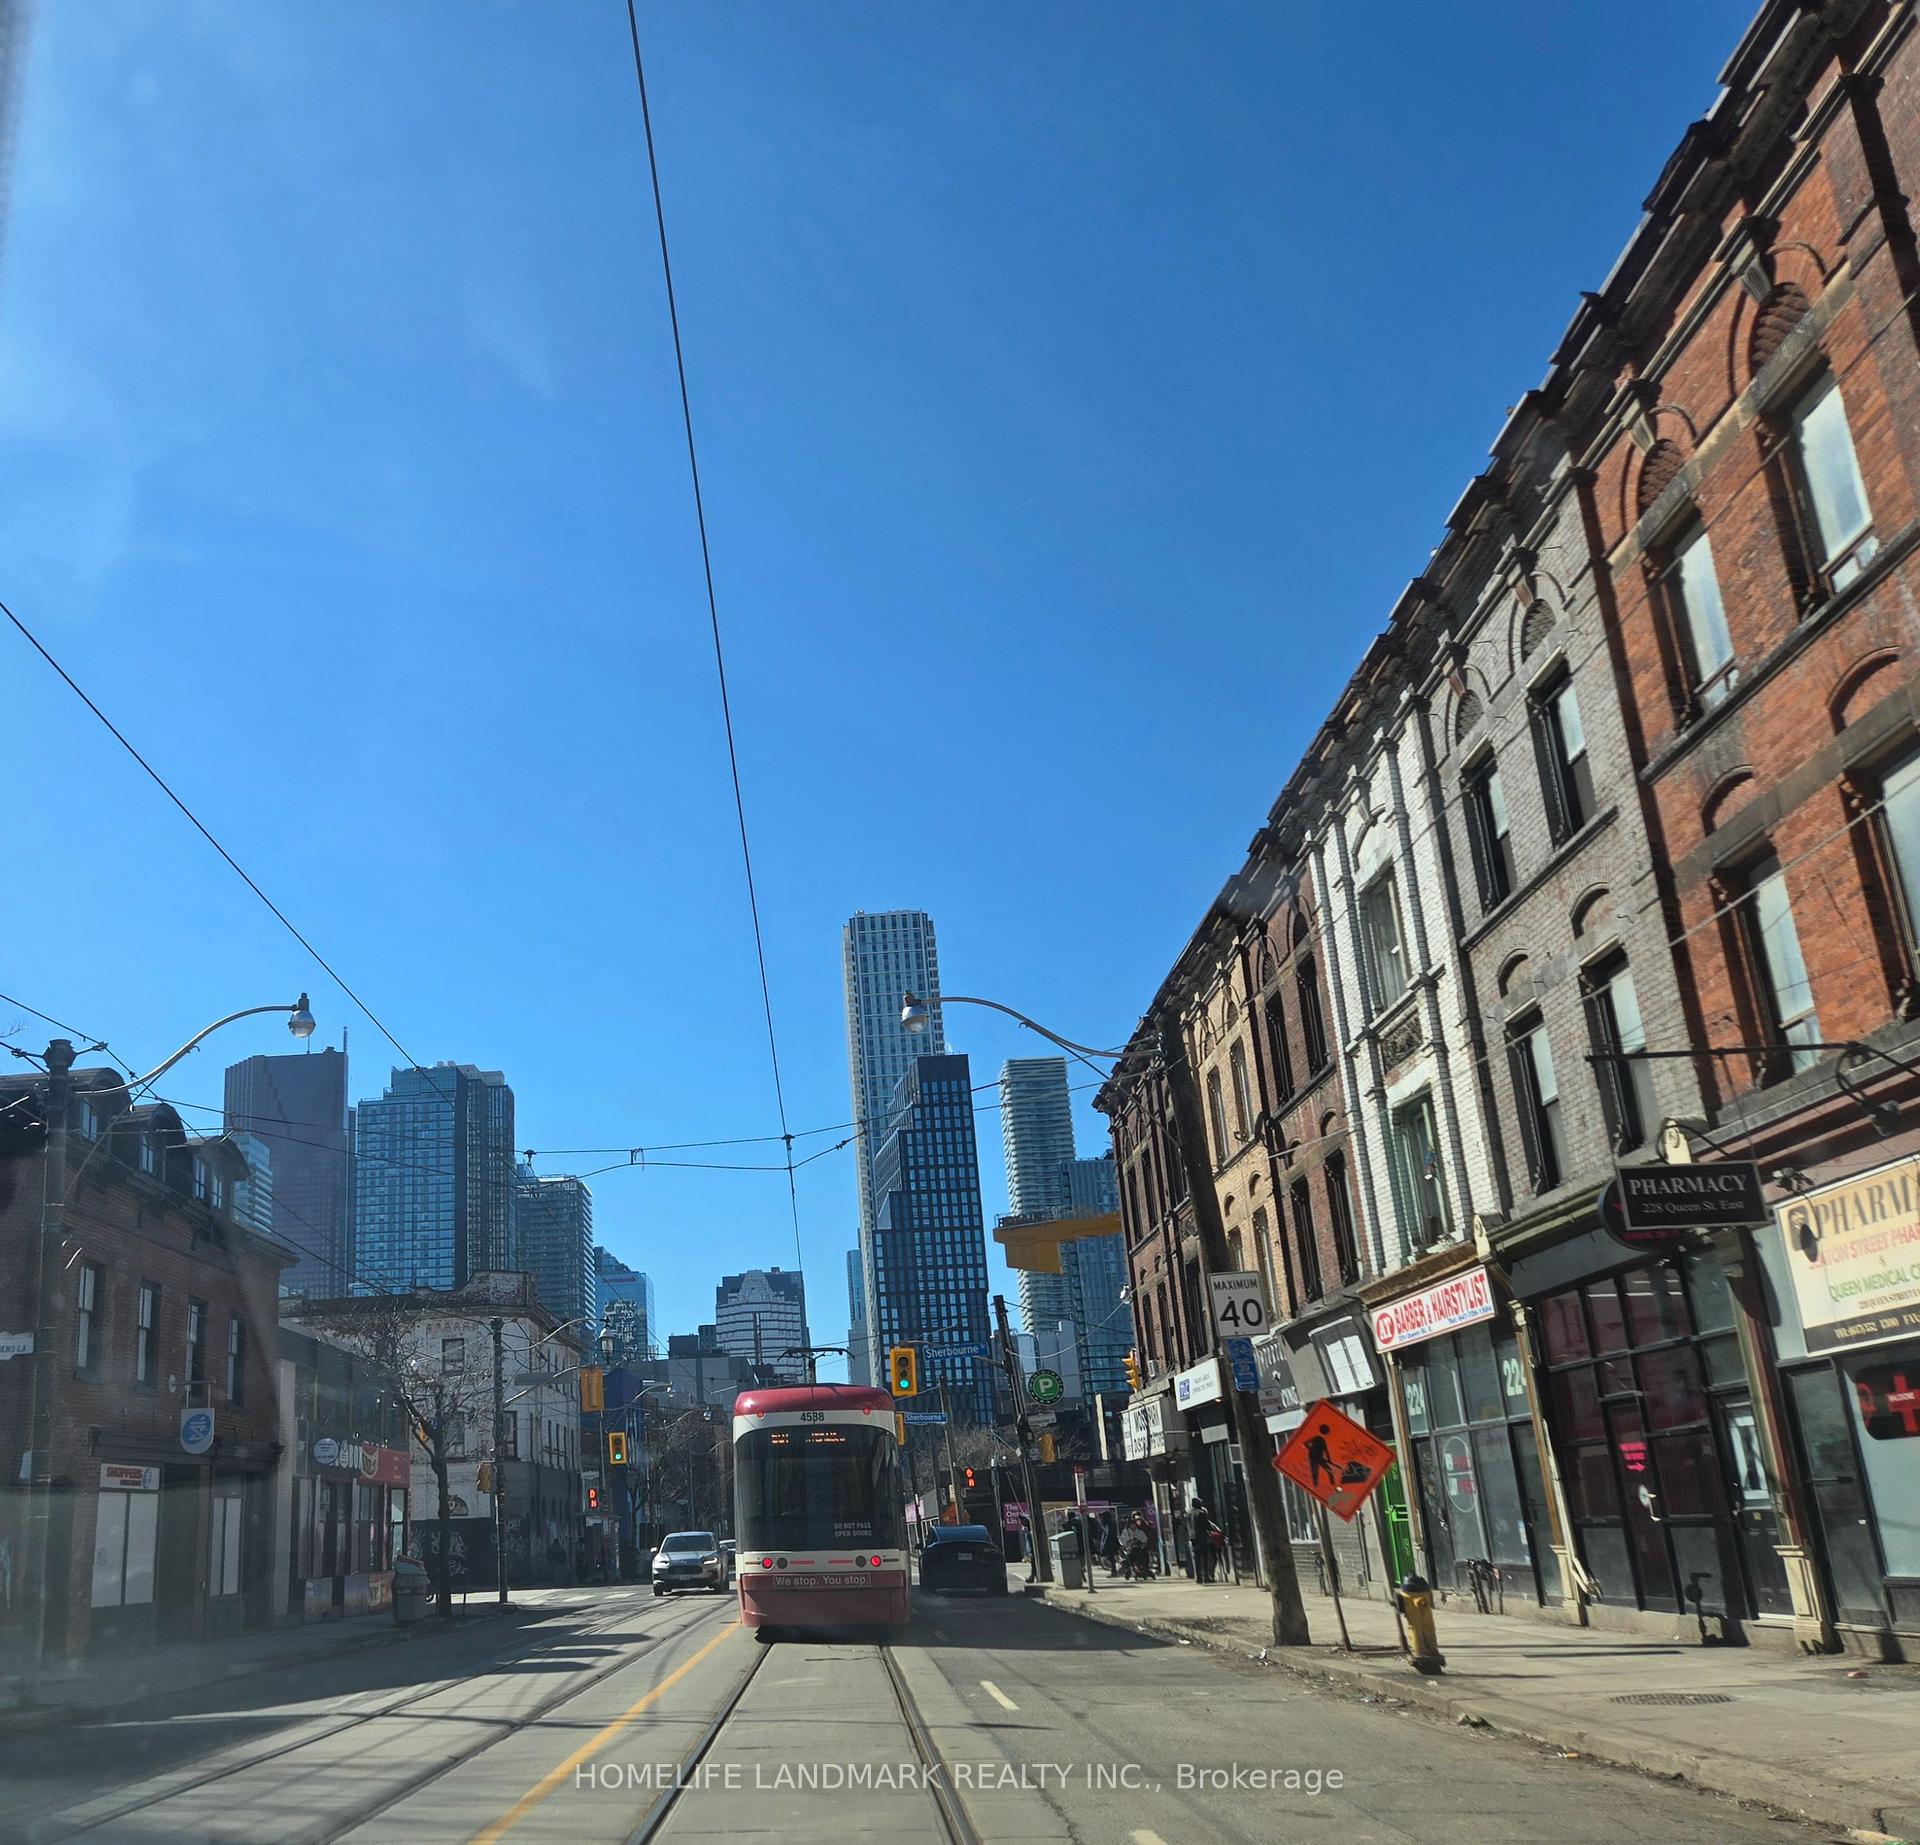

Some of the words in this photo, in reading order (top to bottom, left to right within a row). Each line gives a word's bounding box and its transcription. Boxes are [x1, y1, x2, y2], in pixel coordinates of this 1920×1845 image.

[1629, 1174, 1746, 1196] PHARMACY
[1664, 1201, 1701, 1214] Queen
[1721, 1199, 1745, 1210] East
[1814, 1175, 1920, 1239] PHARM
[1850, 1232, 1889, 1259] STREET
[1213, 1278, 1258, 1291] MAXIMUM
[1829, 1278, 1863, 1303] QUEEN
[1863, 1266, 1910, 1291] MEDICAL
[1394, 1298, 1428, 1335] BARBER
[1430, 1273, 1489, 1322] HAIRSTYLIST
[1220, 1298, 1263, 1328] 40
[925, 1345, 980, 1358] Sherbourne
[1038, 1378, 1053, 1393] P
[906, 1412, 942, 1422] Sherbourne
[856, 1521, 872, 1529] PASS
[775, 1576, 791, 1586] We
[793, 1576, 820, 1588] stop.
[822, 1575, 841, 1585] You
[844, 1575, 869, 1587] stop.
